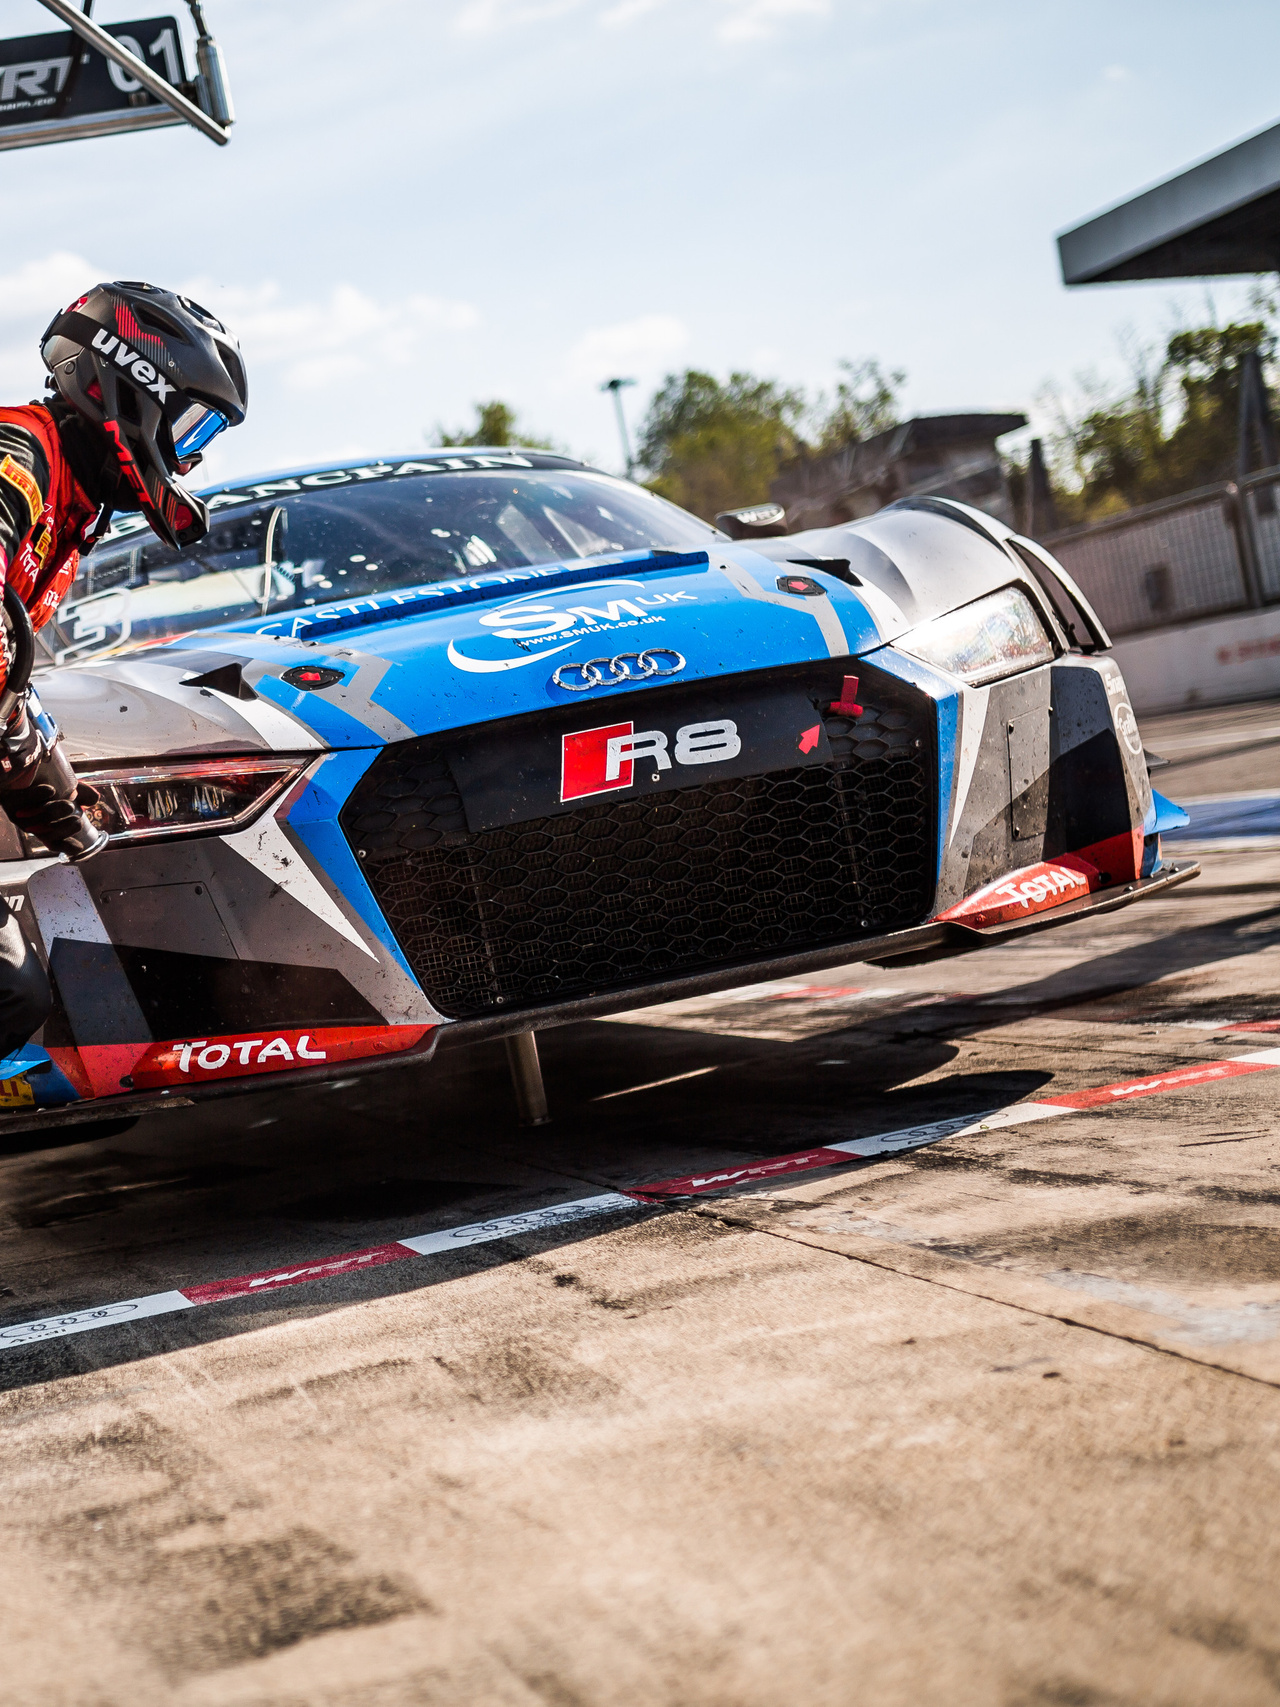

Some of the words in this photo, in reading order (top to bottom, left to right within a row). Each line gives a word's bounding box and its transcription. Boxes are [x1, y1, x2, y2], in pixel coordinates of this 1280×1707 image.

[91, 327, 177, 405] uvex
[99, 454, 534, 546] BANCPAIN
[19, 542, 40, 583] TOTA
[605, 718, 742, 782] R8
[995, 866, 1087, 909] TOTAL
[172, 1035, 327, 1073] TOTAL
